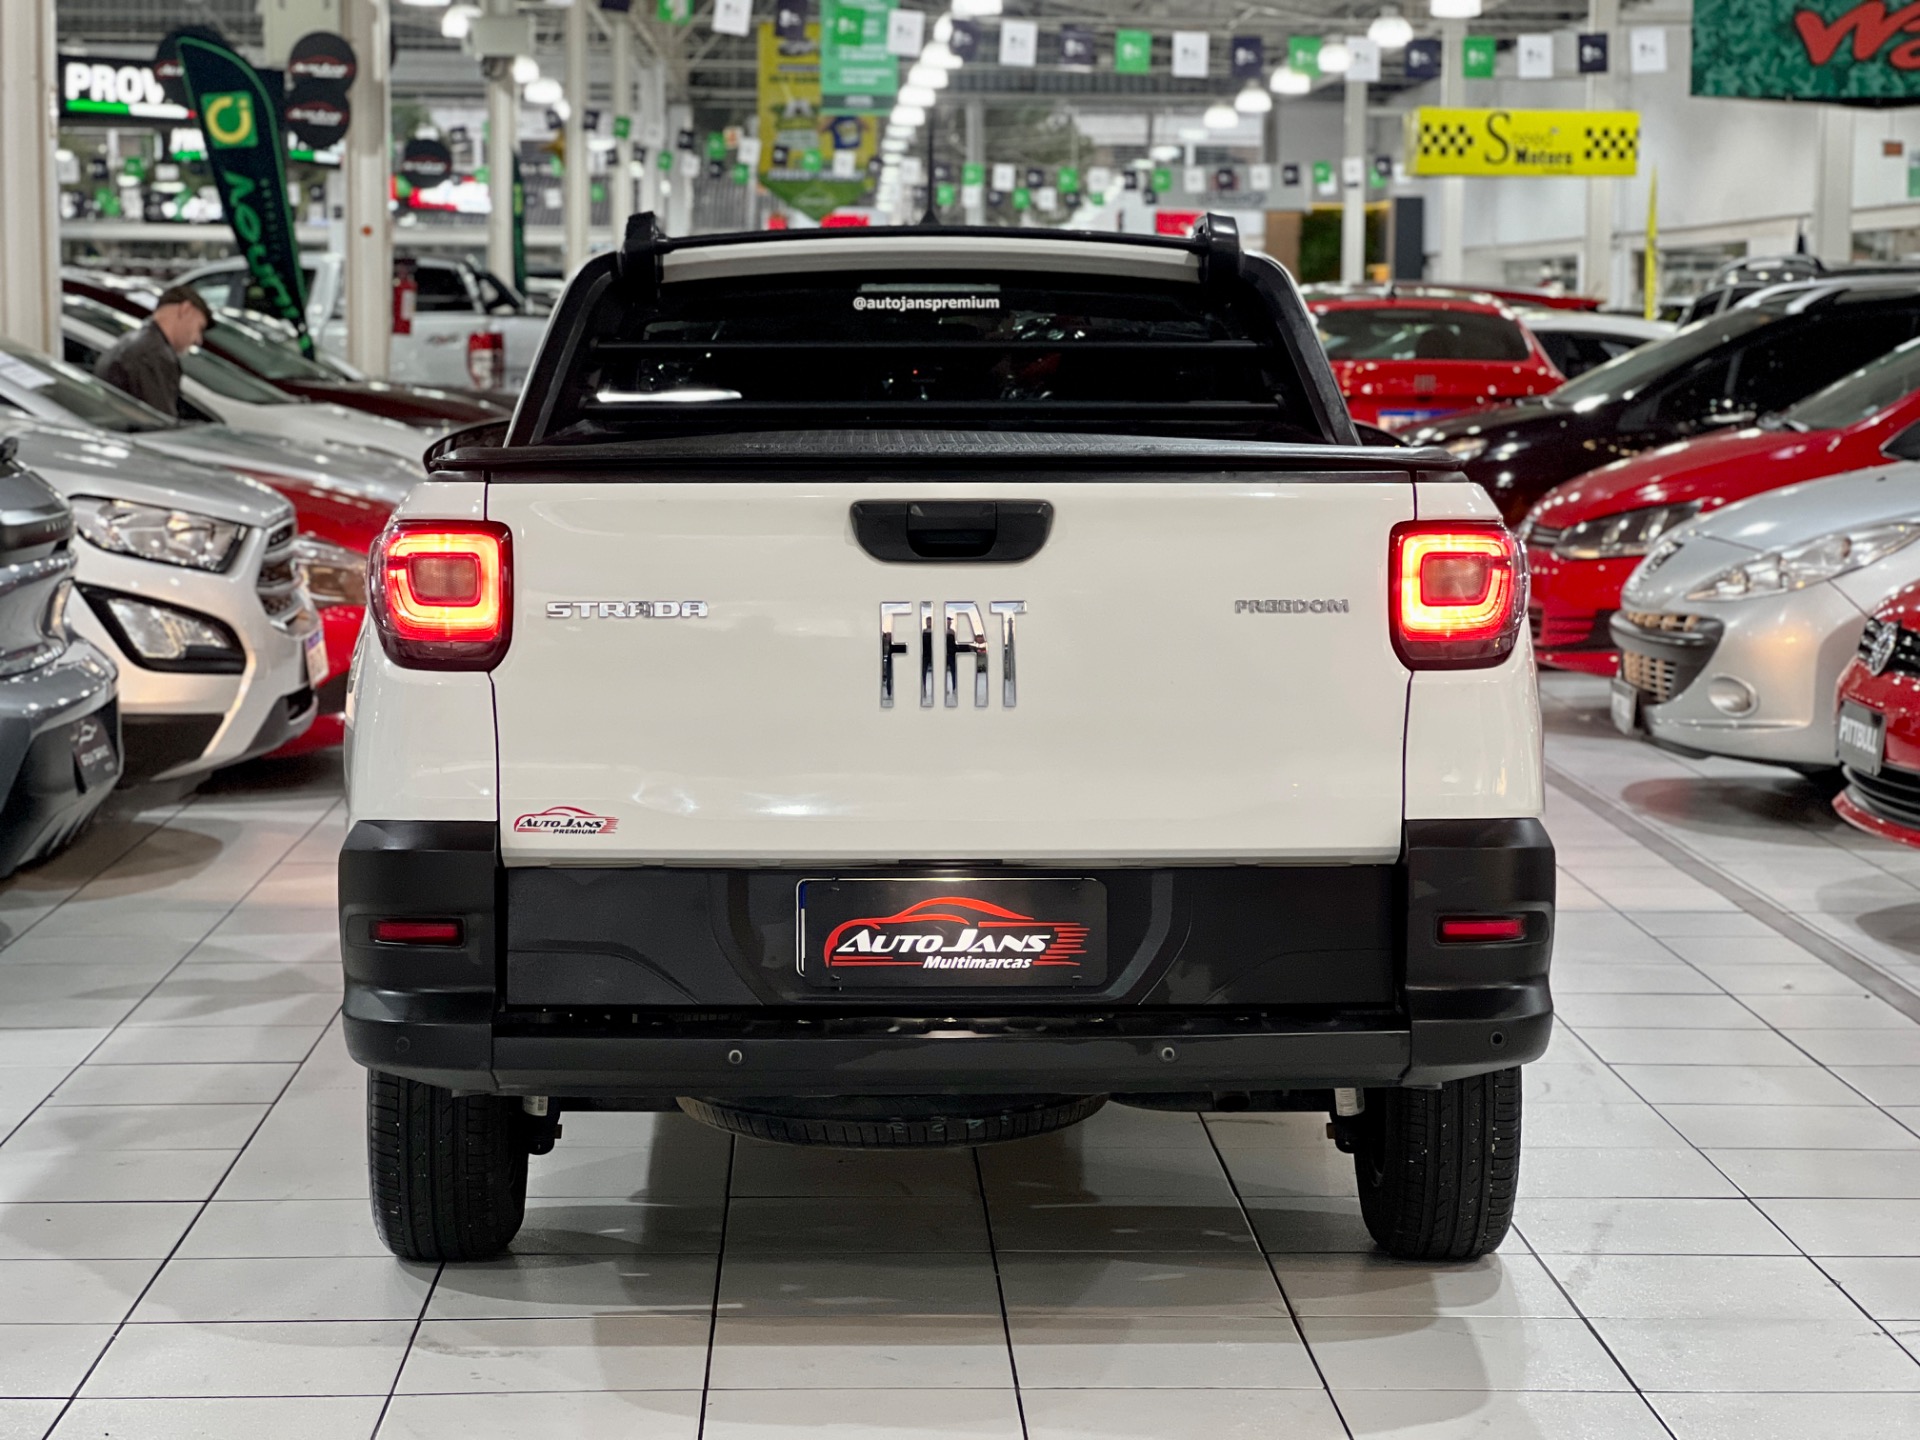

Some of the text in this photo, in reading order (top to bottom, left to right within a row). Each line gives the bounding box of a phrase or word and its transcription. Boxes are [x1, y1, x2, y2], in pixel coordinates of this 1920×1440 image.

[853, 295, 1000, 312] @autojanspremium
[546, 600, 709, 619] STRADA
[1234, 599, 1350, 614] FREEDOM
[879, 600, 1028, 709] FIAT
[922, 955, 1033, 970] Multimarcas
